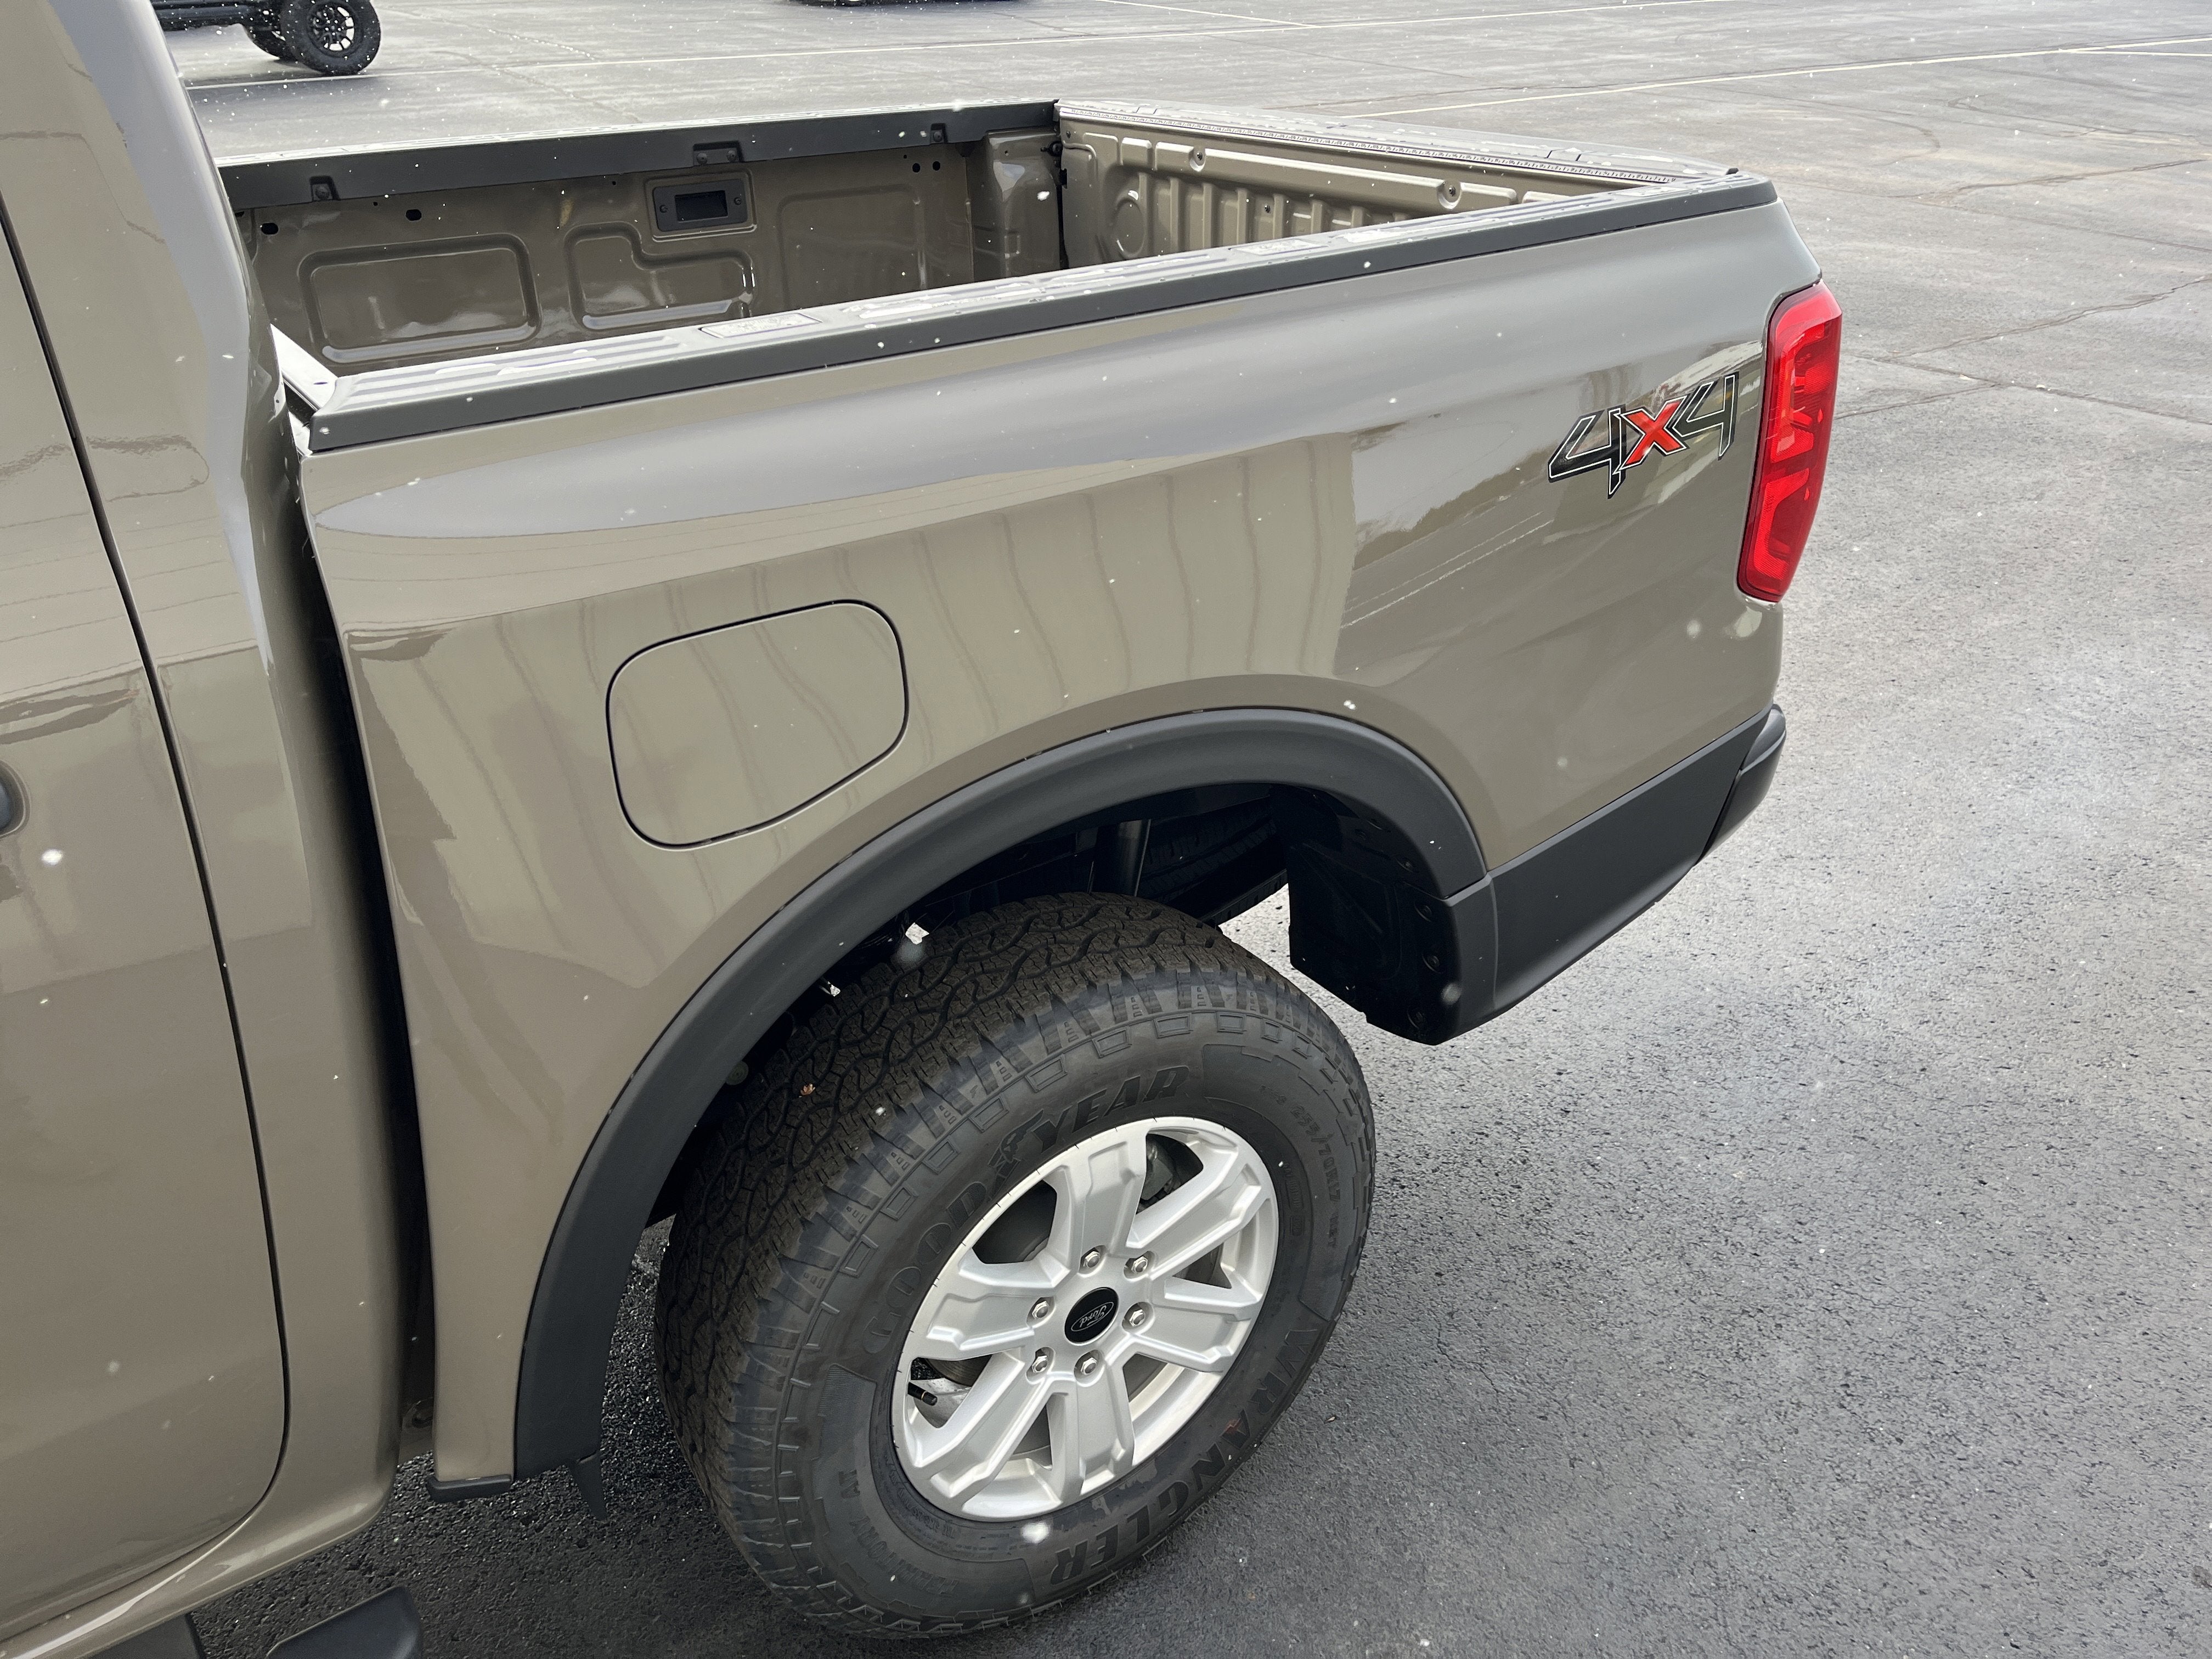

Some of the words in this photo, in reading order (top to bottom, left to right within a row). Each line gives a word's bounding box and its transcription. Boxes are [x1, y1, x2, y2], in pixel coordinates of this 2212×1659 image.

[1079, 1305, 1107, 1328] Ford
[1051, 1329, 1322, 1585] WRANGLER
[850, 1516, 960, 1598] TERRITORY
